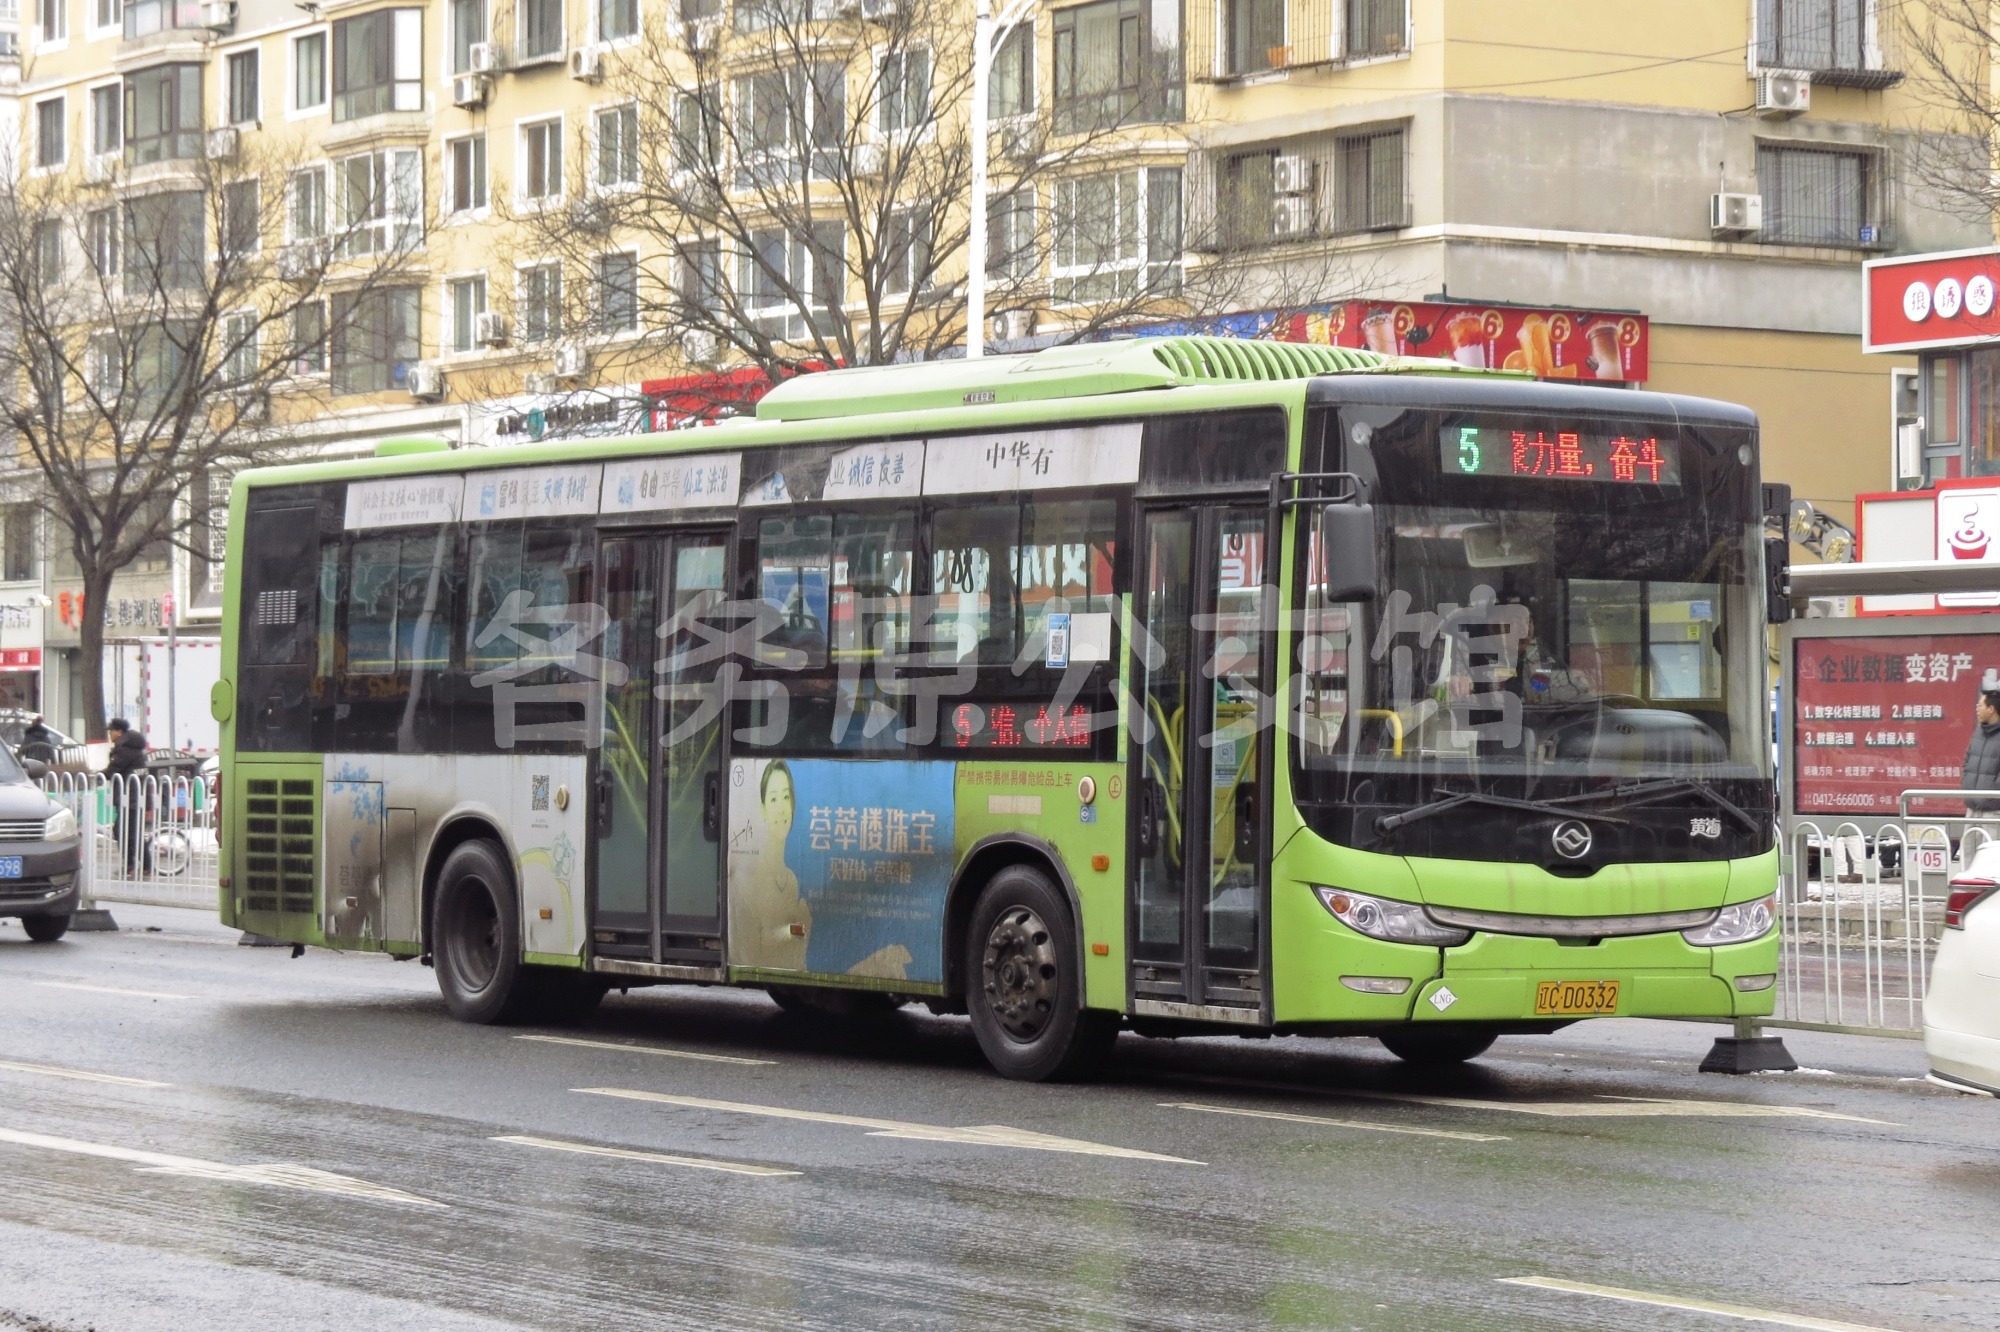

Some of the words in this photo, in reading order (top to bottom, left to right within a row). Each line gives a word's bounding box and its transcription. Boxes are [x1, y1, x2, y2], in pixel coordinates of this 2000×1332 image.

[1911, 283, 1987, 311] 狼诱惑
[1397, 308, 1409, 332] 6
[1484, 313, 1498, 335] 6
[1551, 317, 1566, 340] 6
[1619, 321, 1635, 344] 8
[986, 440, 1054, 476] 中华有
[1458, 427, 1481, 473] 5
[878, 452, 906, 487] 友善
[639, 469, 659, 499] 自由
[683, 467, 704, 497] 公正
[706, 464, 729, 496] 法治
[1818, 652, 1973, 683] 企业数据变资产
[1804, 704, 1881, 719] 1.数字化转型规划
[1891, 704, 1942, 719] 2.数据咨询
[956, 705, 972, 747] 5
[1804, 731, 1854, 745] 3.数据治理
[1865, 731, 1916, 745] 4.数据入表
[957, 769, 1074, 788] 严禁携带易燃易爆危险品上车
[1812, 793, 1875, 806] 0412-6660006
[809, 805, 936, 856] 荟萃楼珠宝
[1689, 817, 1722, 838] 黄海
[1433, 993, 1453, 1005] LNG
